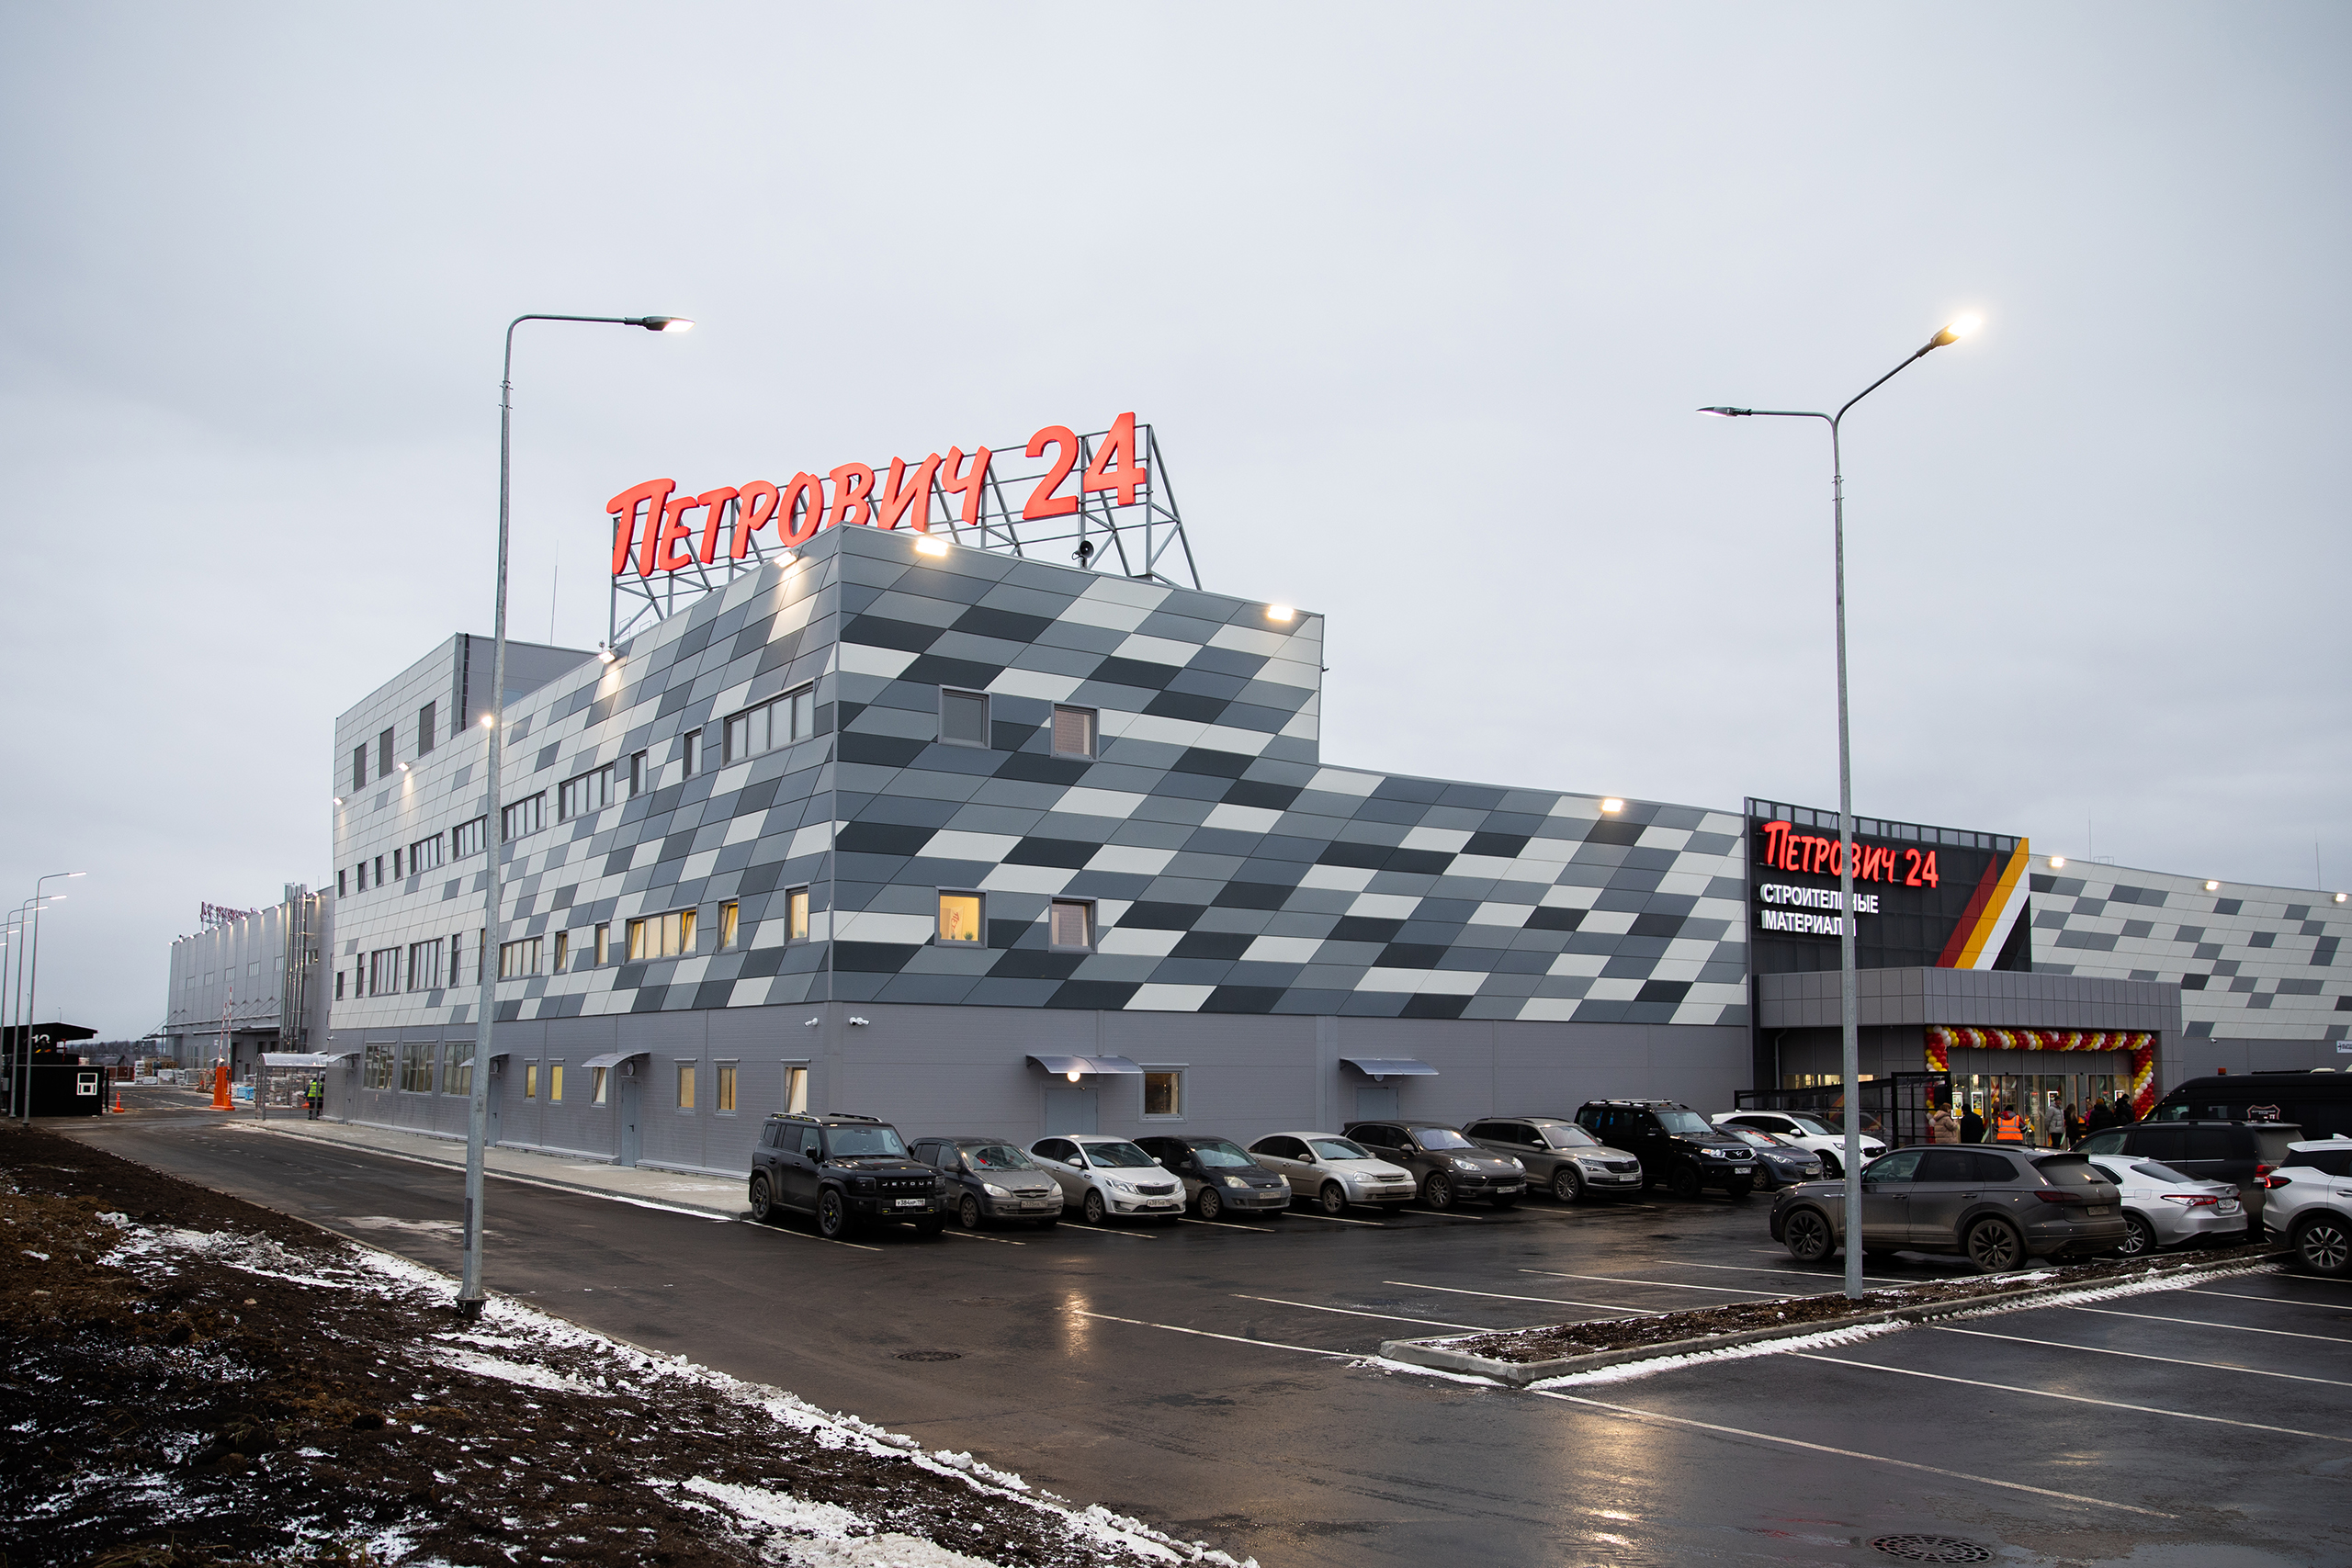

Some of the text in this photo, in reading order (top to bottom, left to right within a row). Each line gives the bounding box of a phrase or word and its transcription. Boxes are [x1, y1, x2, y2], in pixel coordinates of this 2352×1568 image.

[606, 412, 1147, 578] ПЕТРОВИЧ 24
[1903, 848, 1939, 888] 24
[1761, 909, 1857, 937] МАТЕРИАЛ
